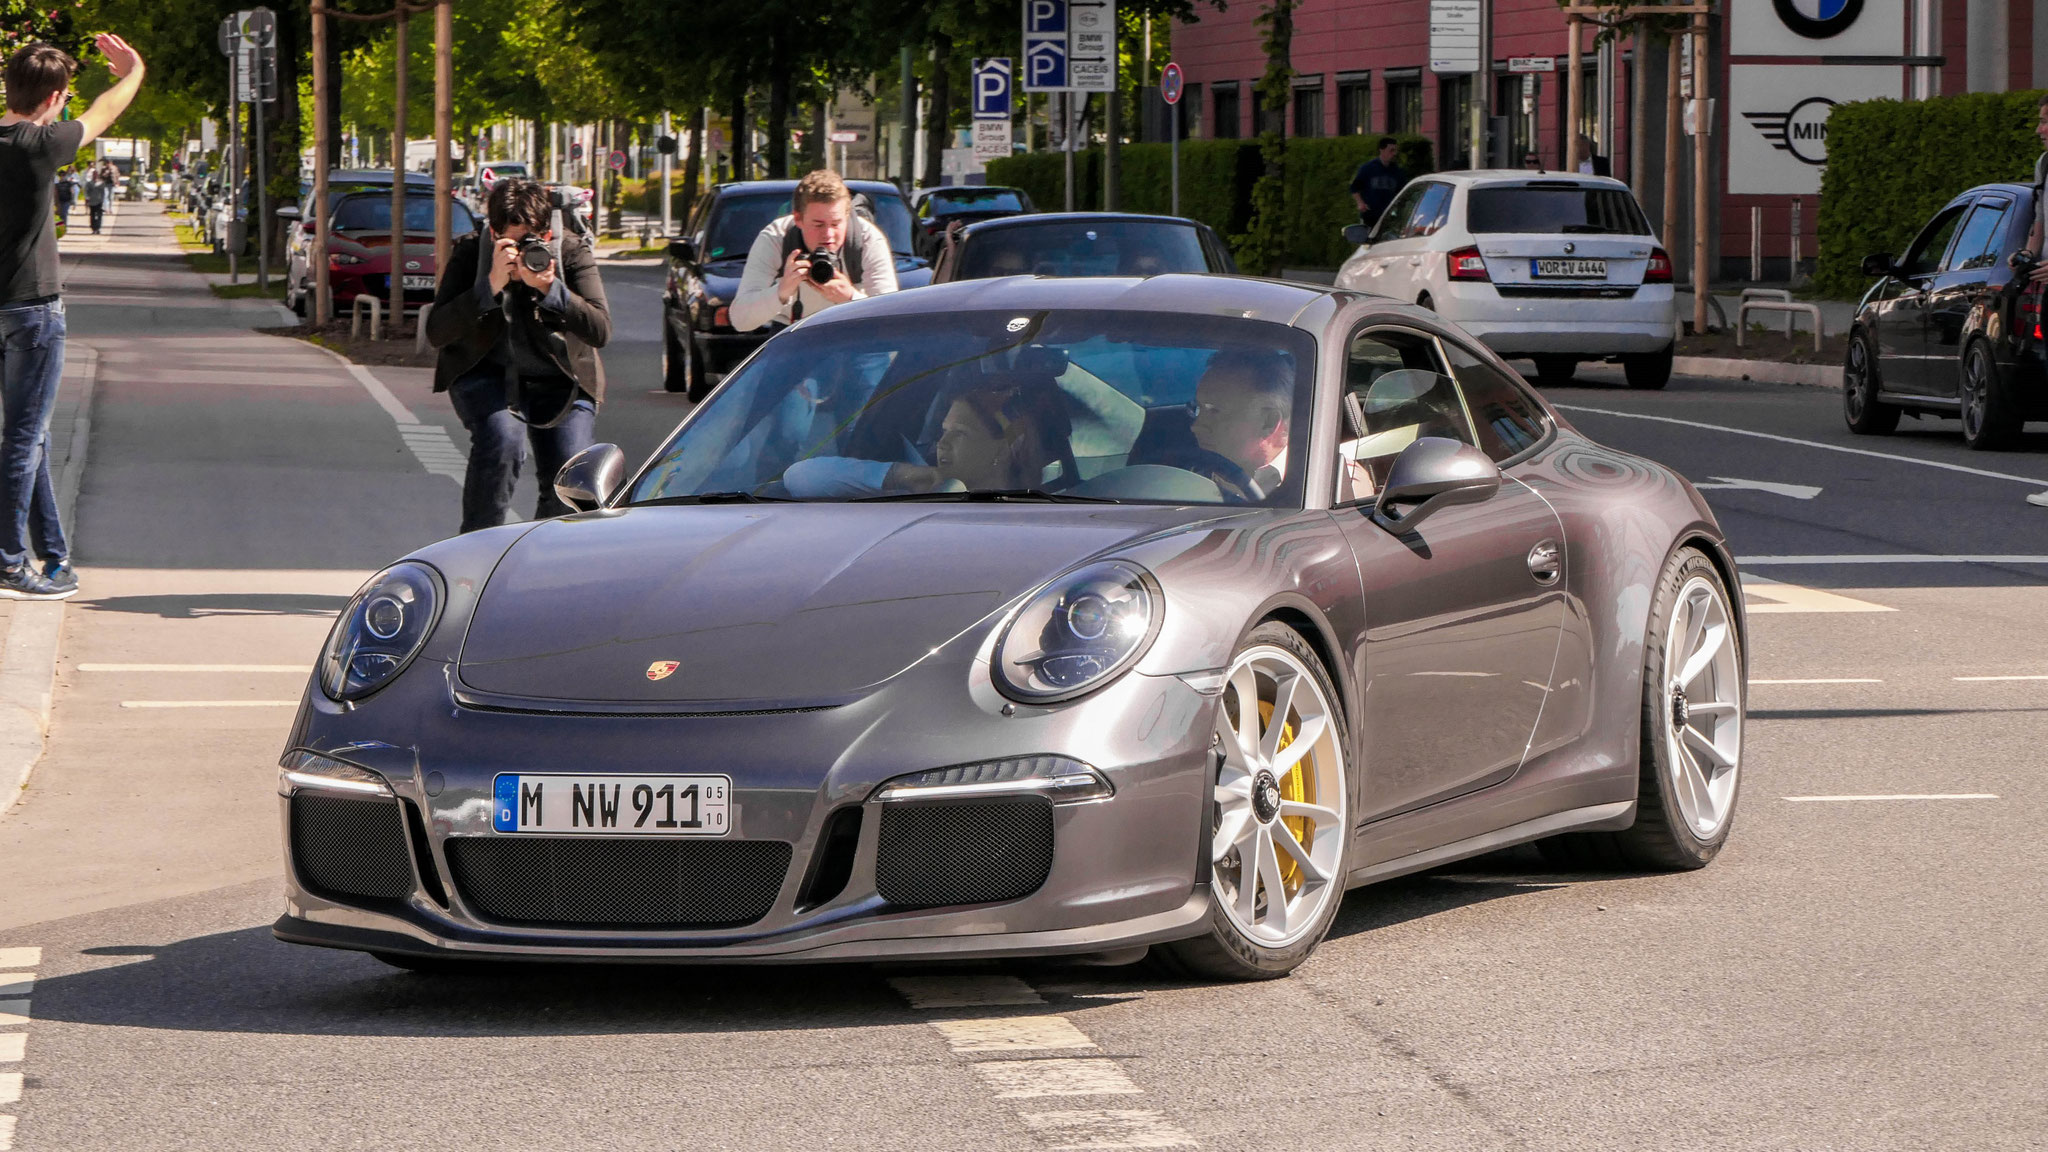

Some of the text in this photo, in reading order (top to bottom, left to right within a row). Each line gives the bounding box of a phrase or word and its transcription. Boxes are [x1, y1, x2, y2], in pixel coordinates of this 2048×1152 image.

[1079, 34, 1103, 42] BMW
[1078, 43, 1104, 51] Group
[1032, 55, 1055, 86] P
[1073, 65, 1108, 73] CACEIS
[979, 73, 1005, 111] P
[979, 123, 1004, 131] BMW
[1793, 122, 1829, 140] MIN
[978, 132, 1006, 141] Group
[975, 145, 1009, 153] CACEIS
[1538, 260, 1605, 274] WOR V 4444
[706, 786, 723, 800] 05
[521, 782, 702, 829] M NW 911
[502, 809, 511, 822] D
[706, 812, 723, 826] 10
